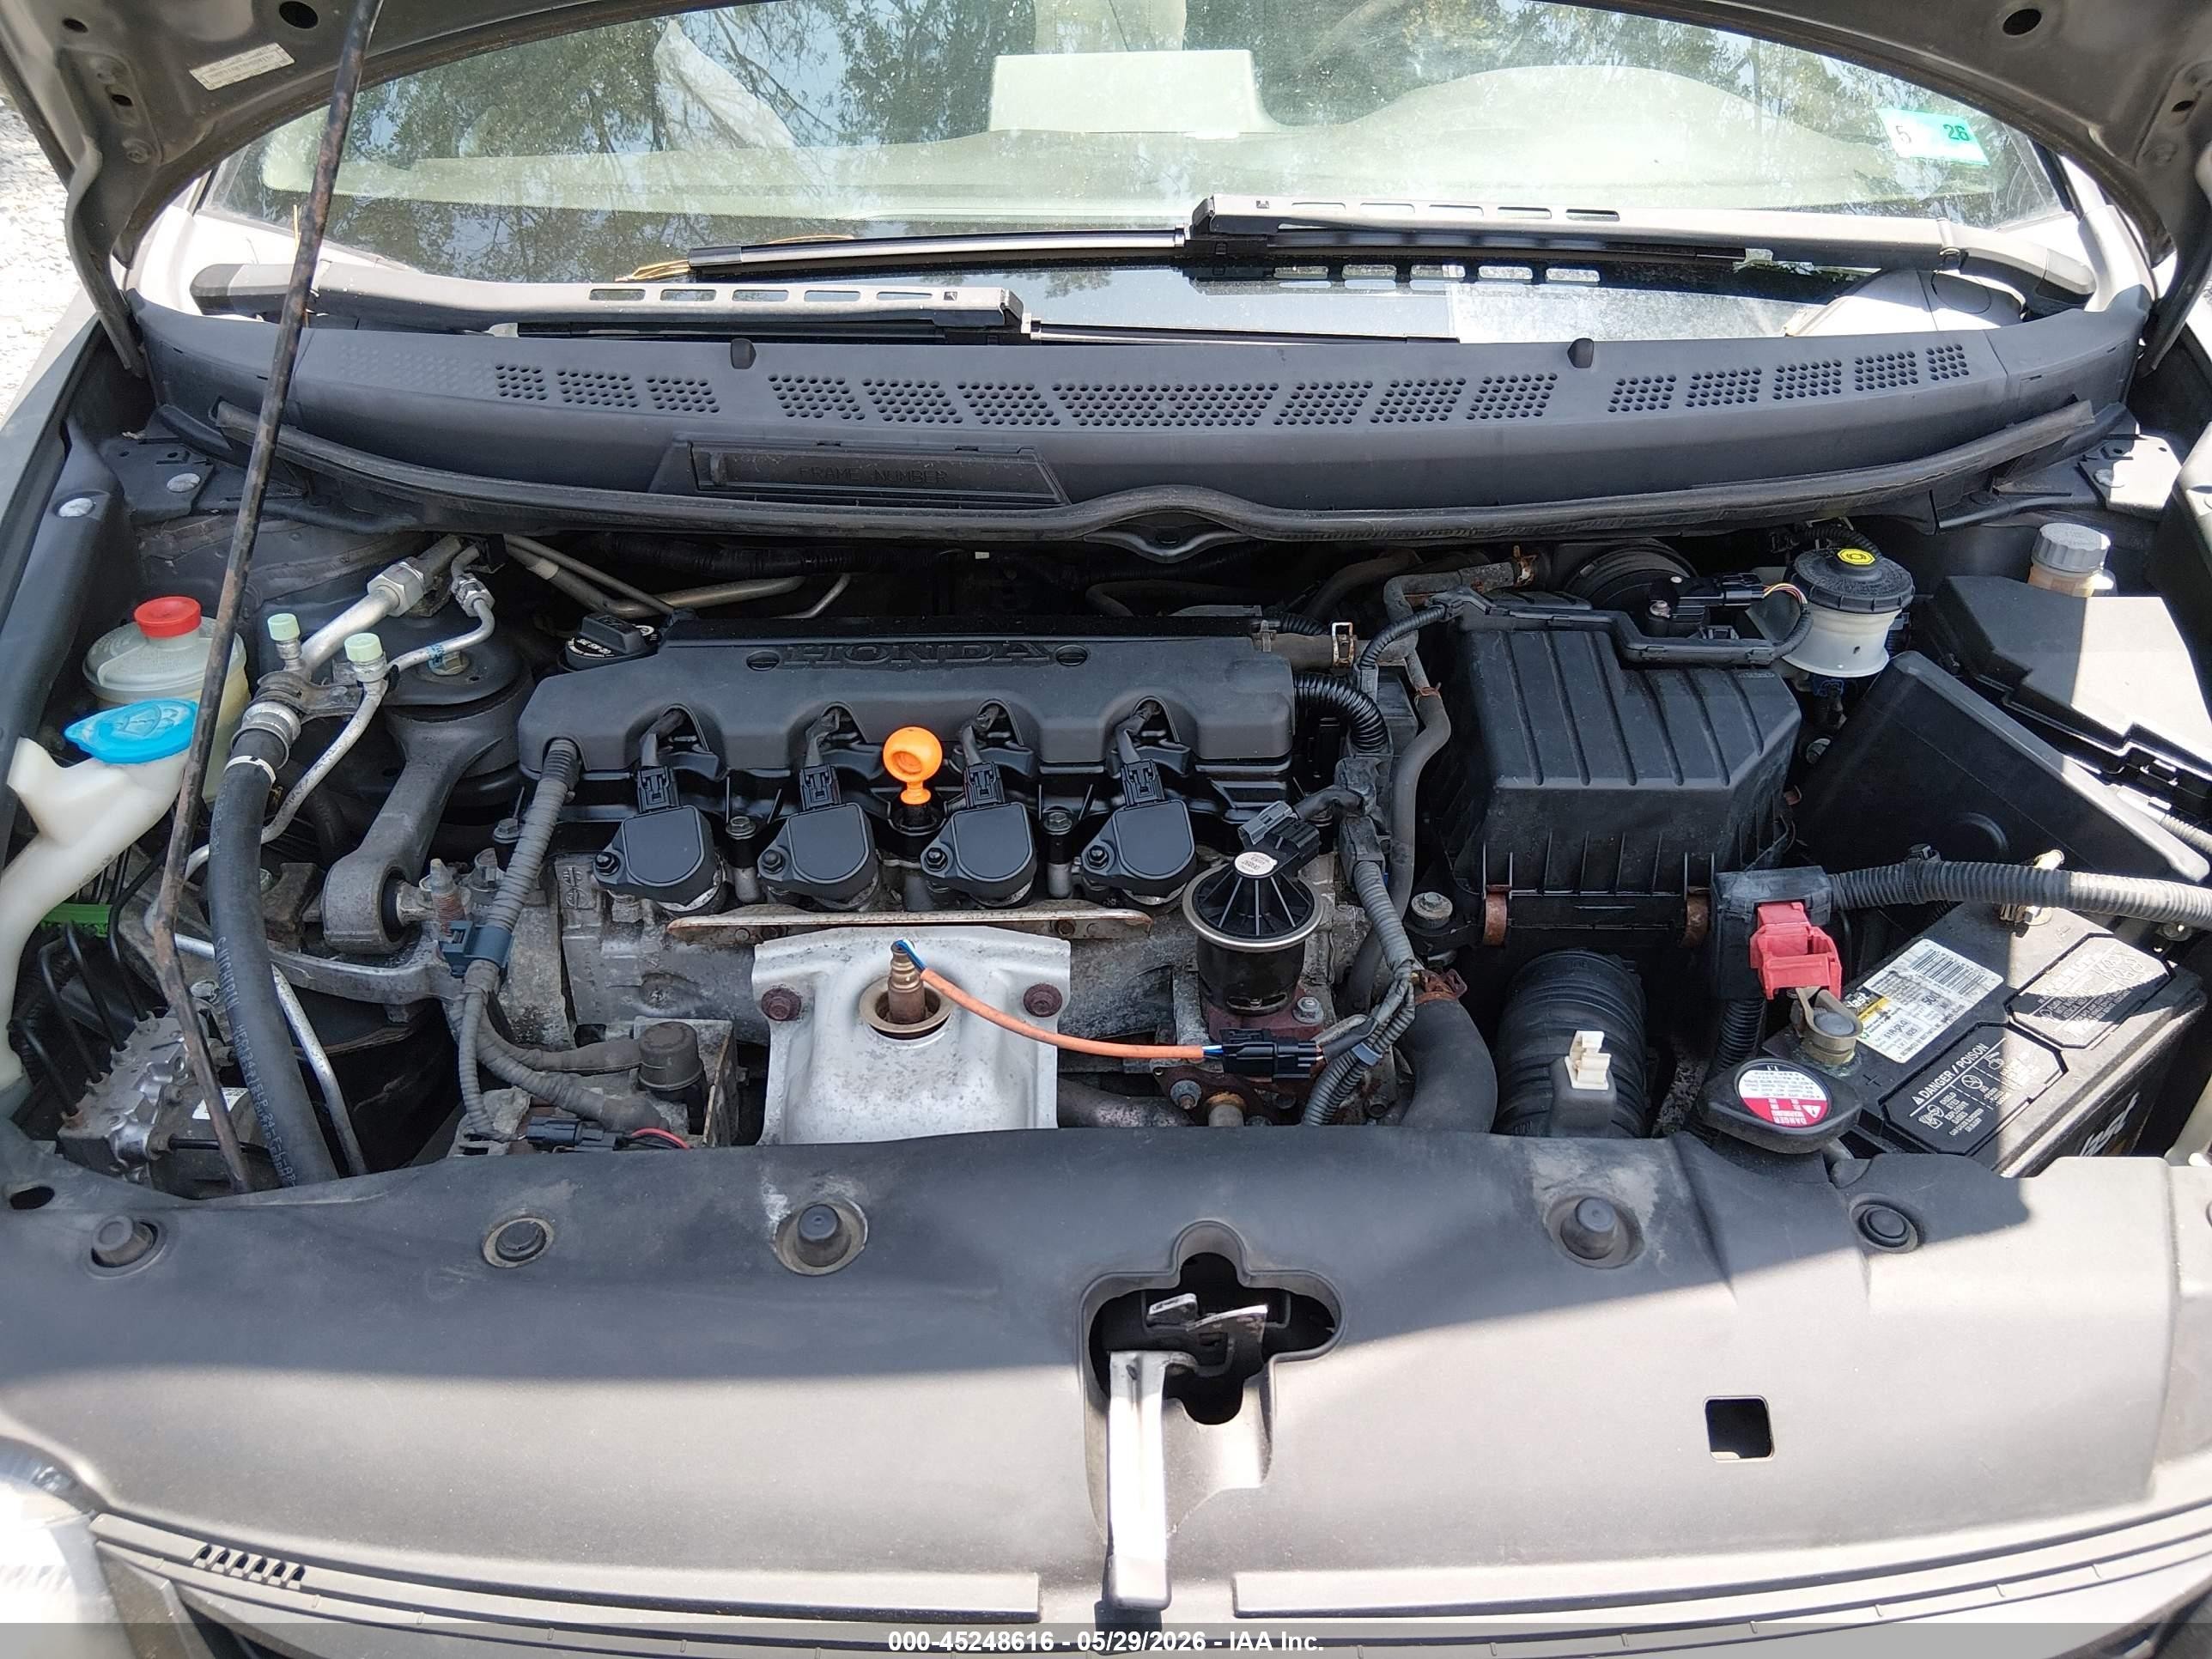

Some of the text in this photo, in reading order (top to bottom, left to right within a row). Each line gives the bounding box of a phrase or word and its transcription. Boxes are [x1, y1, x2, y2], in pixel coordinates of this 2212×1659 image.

[1895, 124, 1971, 144] 5 26
[799, 466, 948, 484] FRAME NUMBER
[782, 643, 1052, 666] HONDA
[1917, 1069, 1956, 1100] DANGER
[1955, 1042, 1990, 1073] POISON
